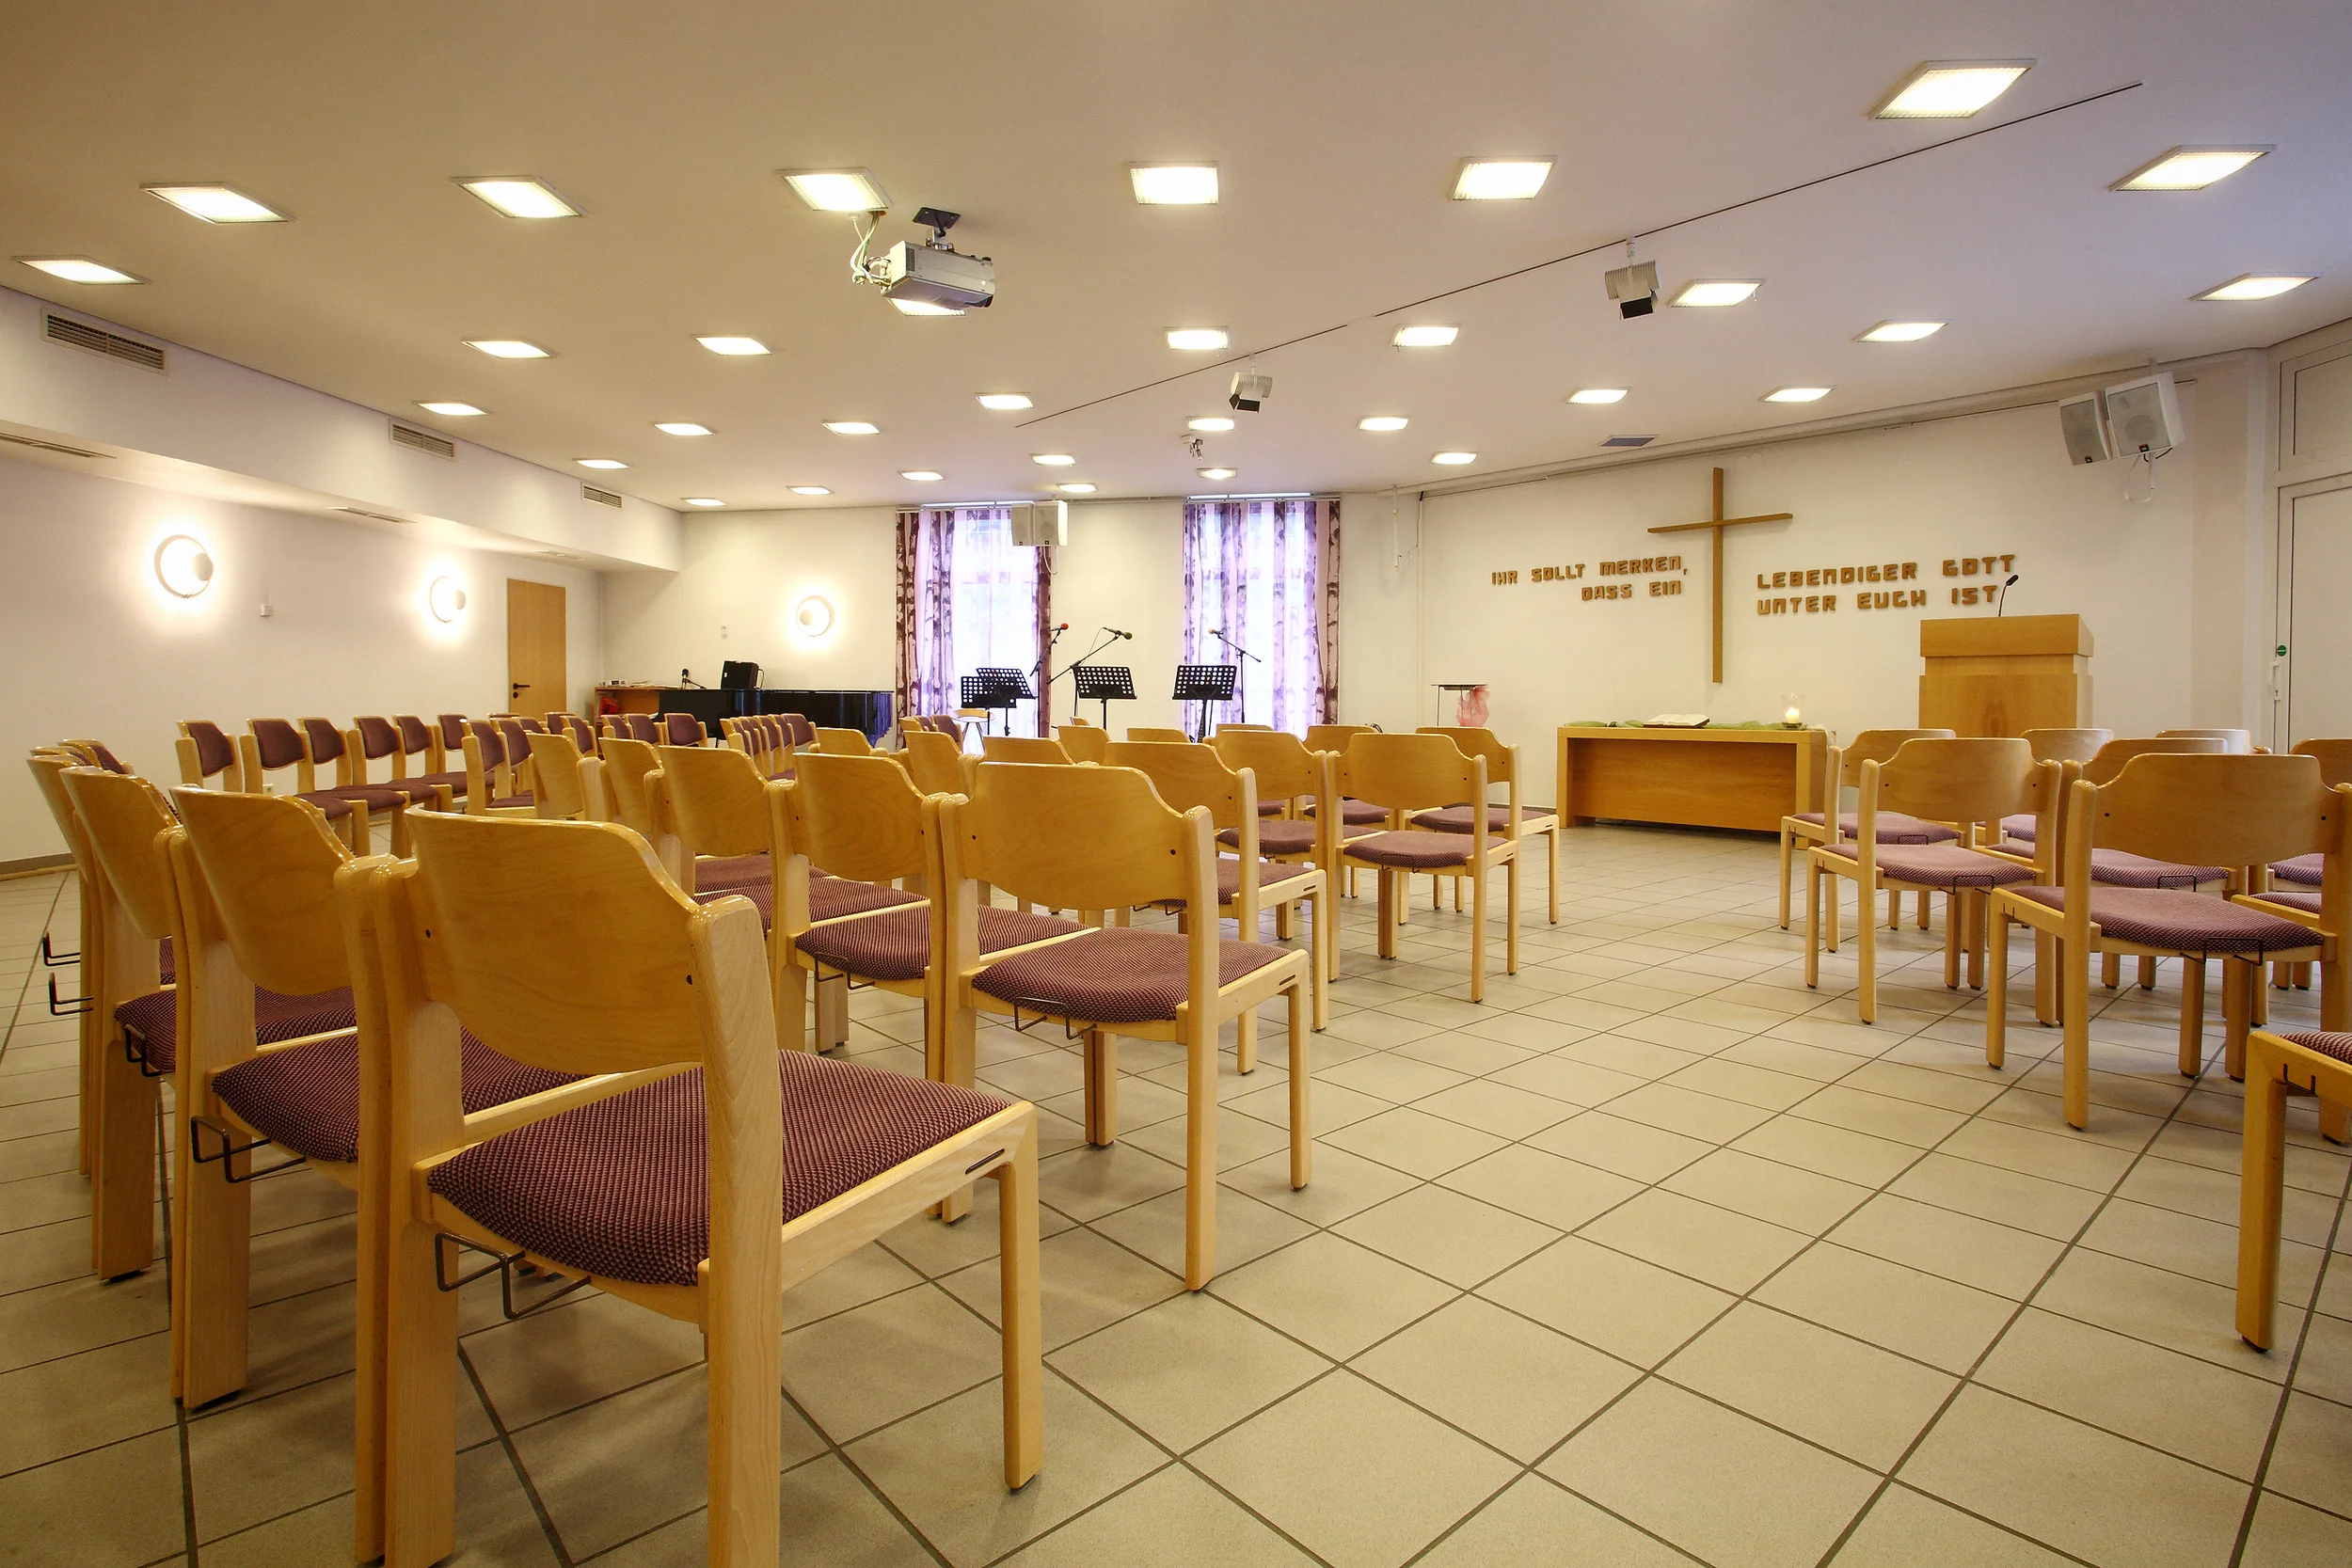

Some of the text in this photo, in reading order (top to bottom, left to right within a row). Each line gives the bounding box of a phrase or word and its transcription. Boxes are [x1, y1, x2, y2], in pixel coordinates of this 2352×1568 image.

[1492, 555, 1688, 585] IHR SOLLT MERKEN,
[1757, 553, 2015, 590] LEBENDIGER GOTT
[1581, 579, 1681, 601] DASS EIN
[1756, 584, 1998, 615] UNTER EUCH IST
